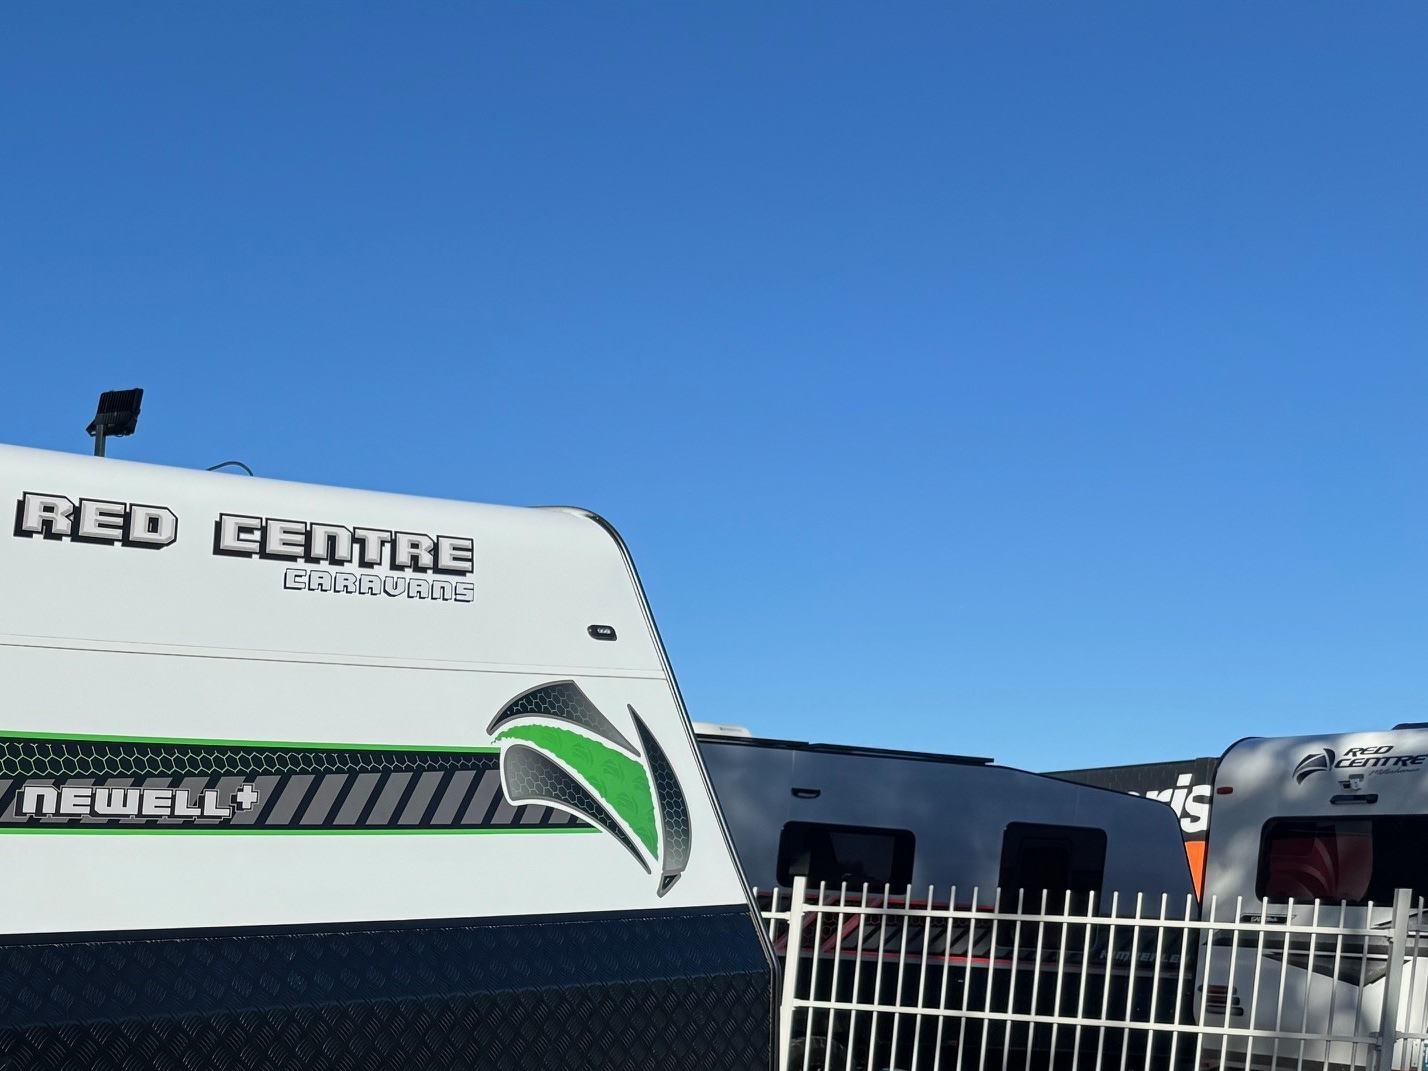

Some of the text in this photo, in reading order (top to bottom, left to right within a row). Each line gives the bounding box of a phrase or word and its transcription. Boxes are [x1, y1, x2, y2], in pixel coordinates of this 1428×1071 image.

[13, 491, 474, 574] RED CENTRE
[283, 567, 474, 603] CARAVANS
[1334, 754, 1428, 768] CENTRE
[1343, 745, 1394, 757] RED
